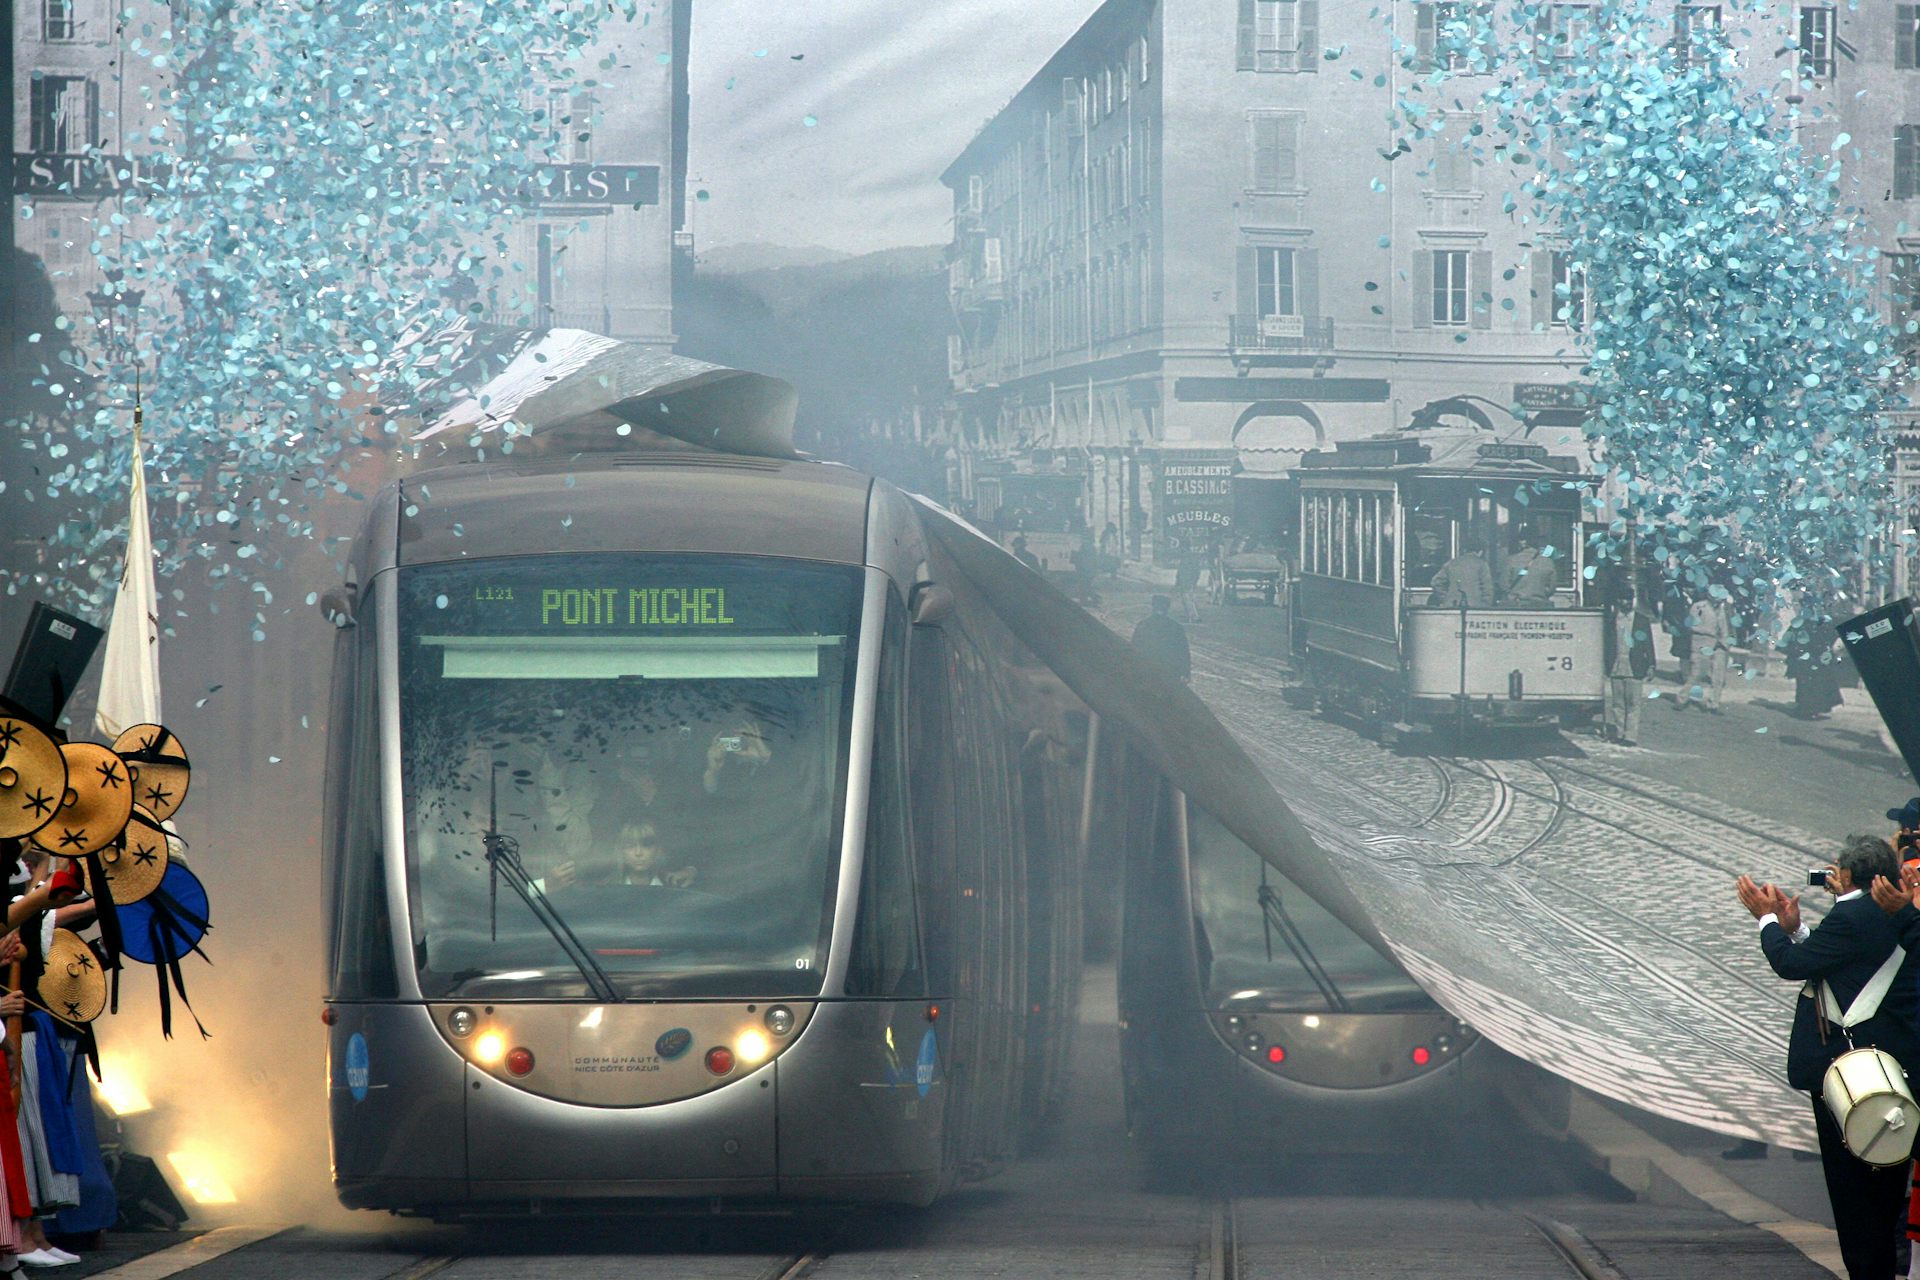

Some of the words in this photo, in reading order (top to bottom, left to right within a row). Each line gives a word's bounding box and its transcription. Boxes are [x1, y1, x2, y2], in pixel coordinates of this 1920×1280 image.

[1165, 466, 1232, 476] AMEUBLEMENTS
[1167, 510, 1231, 526] MEUBLES
[542, 588, 619, 624] PONT
[628, 588, 734, 624] MICHEL
[795, 958, 810, 970] 01
[600, 1064, 624, 1073] CÔTE
[626, 1065, 660, 1073] D'AZUR
